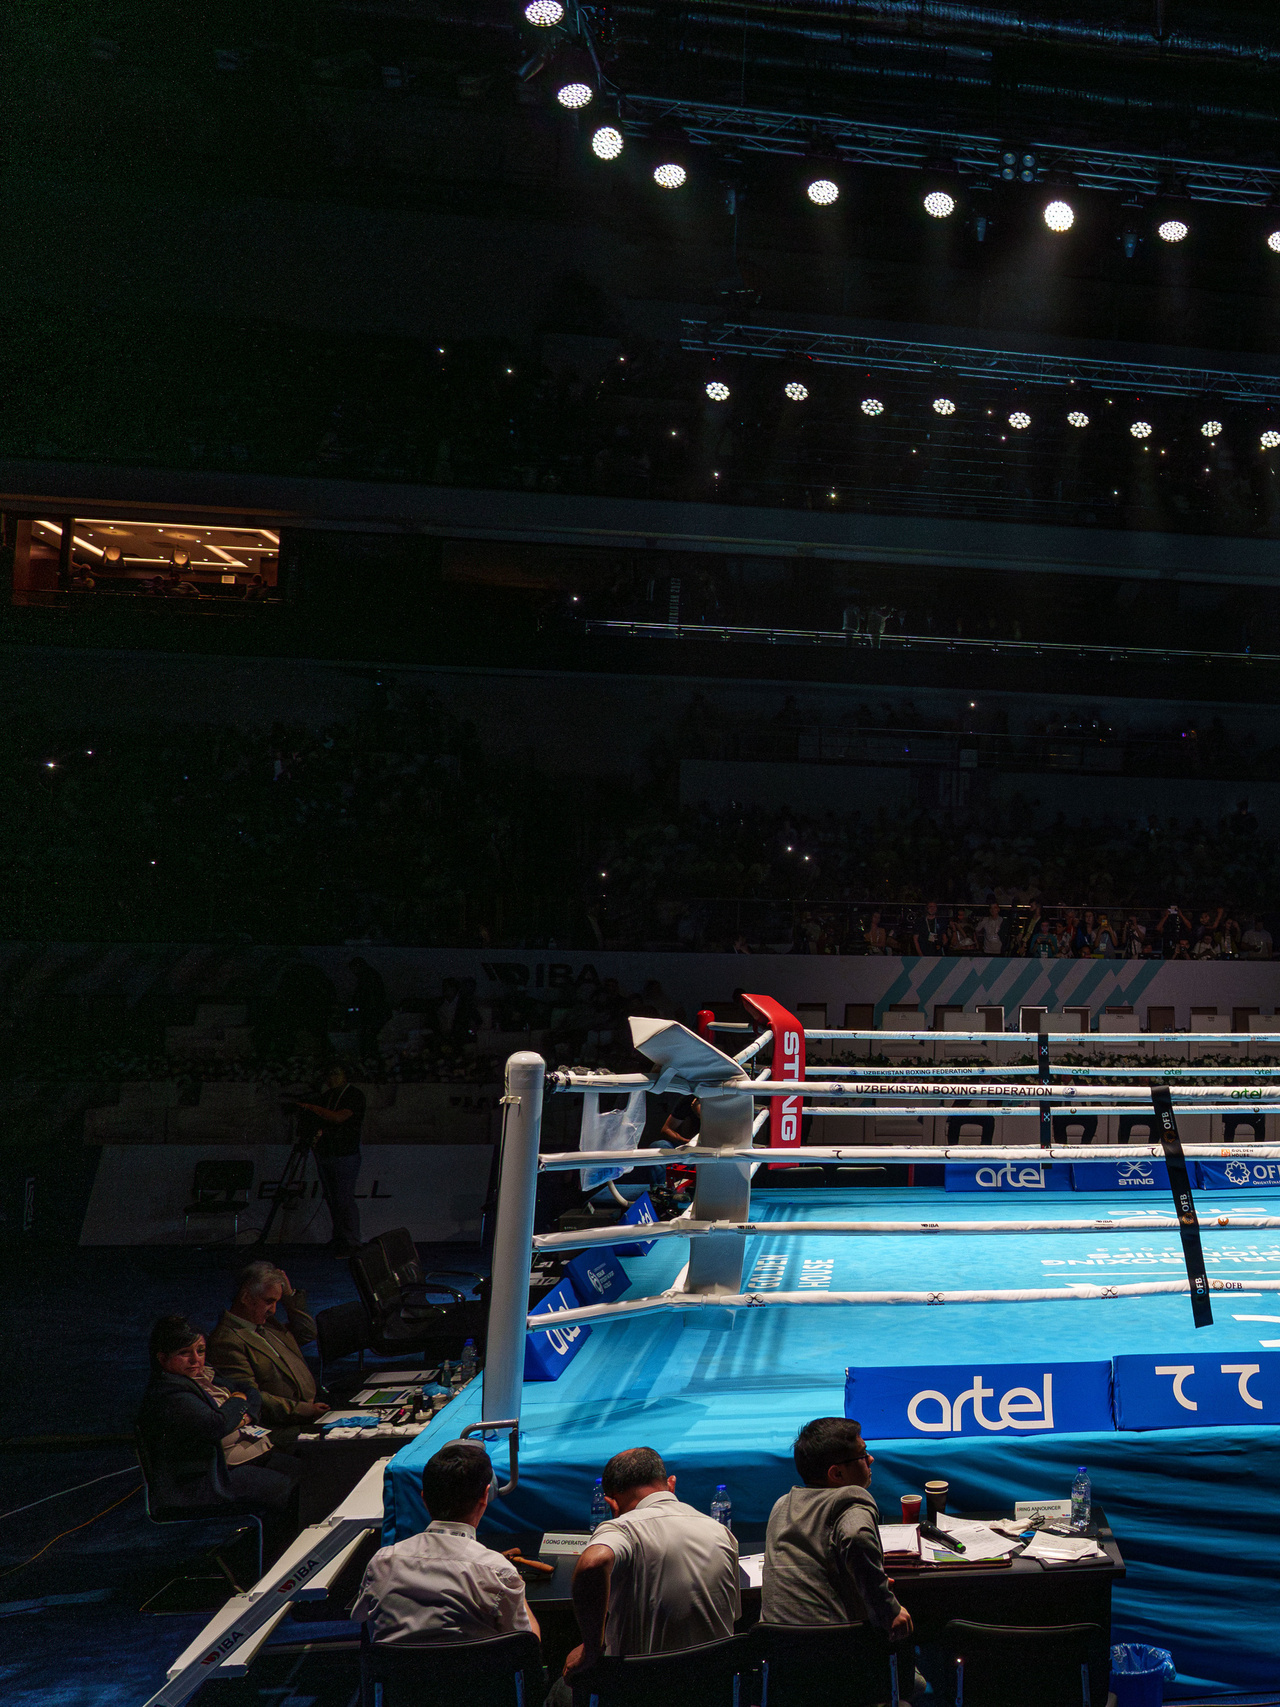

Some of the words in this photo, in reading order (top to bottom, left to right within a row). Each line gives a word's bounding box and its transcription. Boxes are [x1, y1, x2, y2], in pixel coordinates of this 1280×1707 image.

[1072, 1067, 1090, 1075] artel
[781, 1031, 800, 1141] STNG
[856, 1085, 929, 1095] UZBEKISTAN
[932, 1086, 977, 1096] BOXING
[980, 1086, 1053, 1097] FEDERATION
[1231, 1088, 1262, 1099] artel
[1161, 1111, 1172, 1130] OFB
[975, 1162, 1046, 1188] artel
[1118, 1178, 1154, 1186] STING
[1107, 1207, 1268, 1216] STNG
[1179, 1193, 1189, 1212] OFB
[1041, 1257, 1185, 1266] BOXING
[747, 1254, 789, 1289] GOLDEN
[797, 1259, 834, 1288] HOUSE
[1195, 1276, 1205, 1295] OFB
[1225, 1281, 1243, 1289] OFB
[907, 1373, 1055, 1432] artel
[293, 1558, 320, 1582] IBA
[219, 1630, 244, 1654] IBA
